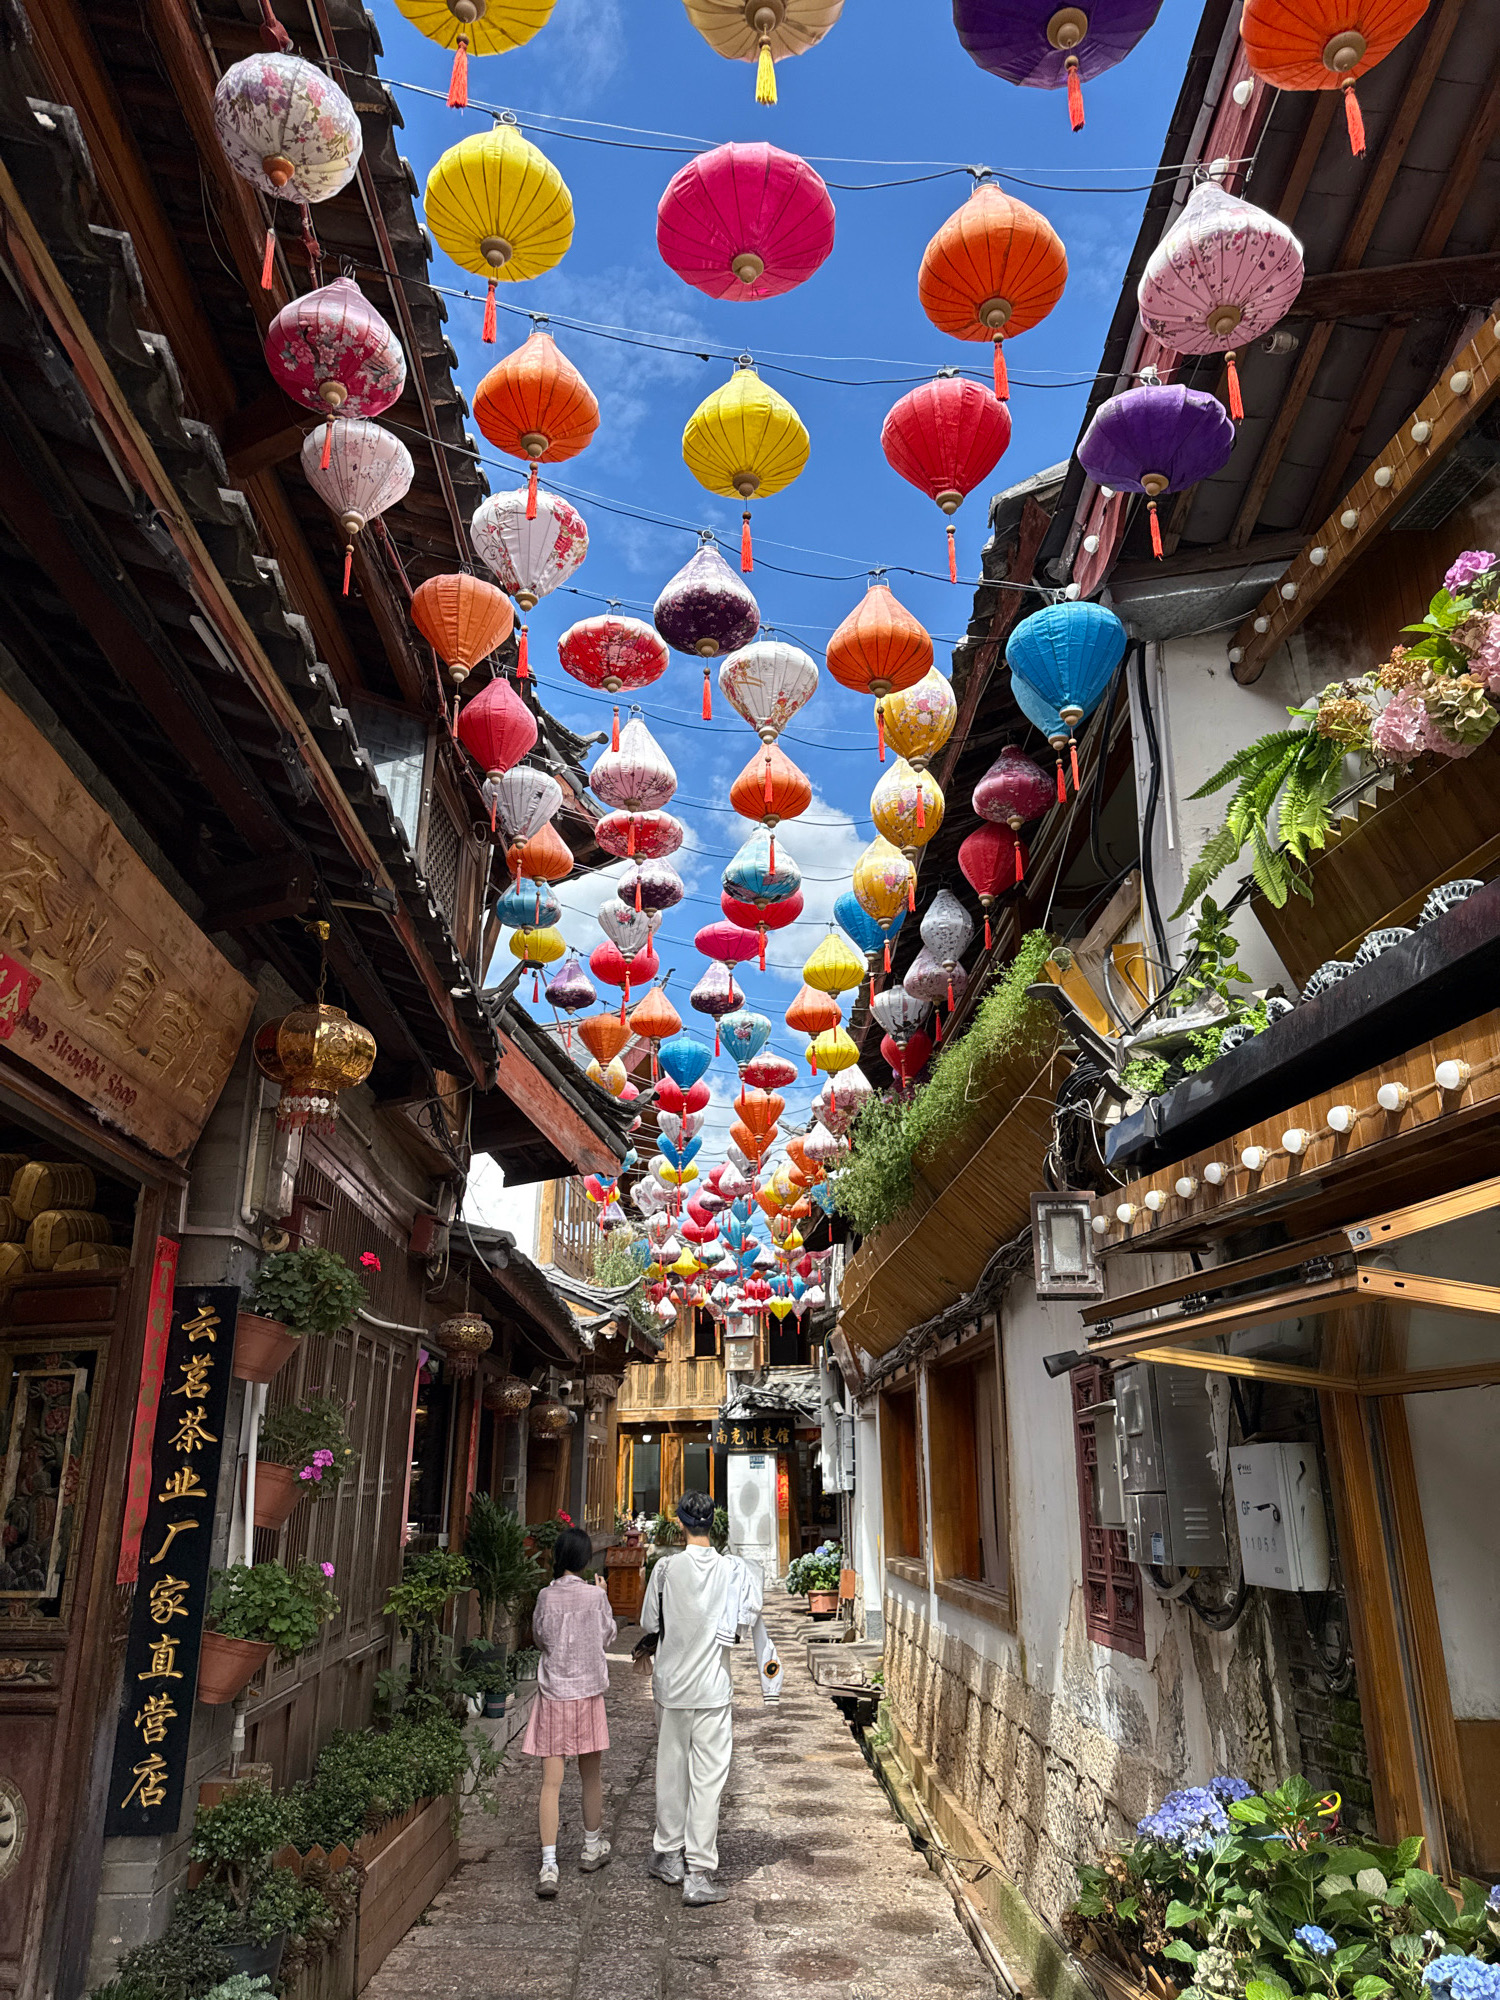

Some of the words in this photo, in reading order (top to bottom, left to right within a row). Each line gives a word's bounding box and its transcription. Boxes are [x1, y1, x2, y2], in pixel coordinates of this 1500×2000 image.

[16, 1009, 48, 1044] hop
[104, 1073, 138, 1111] Shop
[716, 1427, 790, 1446] 南充川菜馆
[1241, 1500, 1251, 1516] GF
[122, 1306, 221, 1809] 云茗茶业厂家直营店
